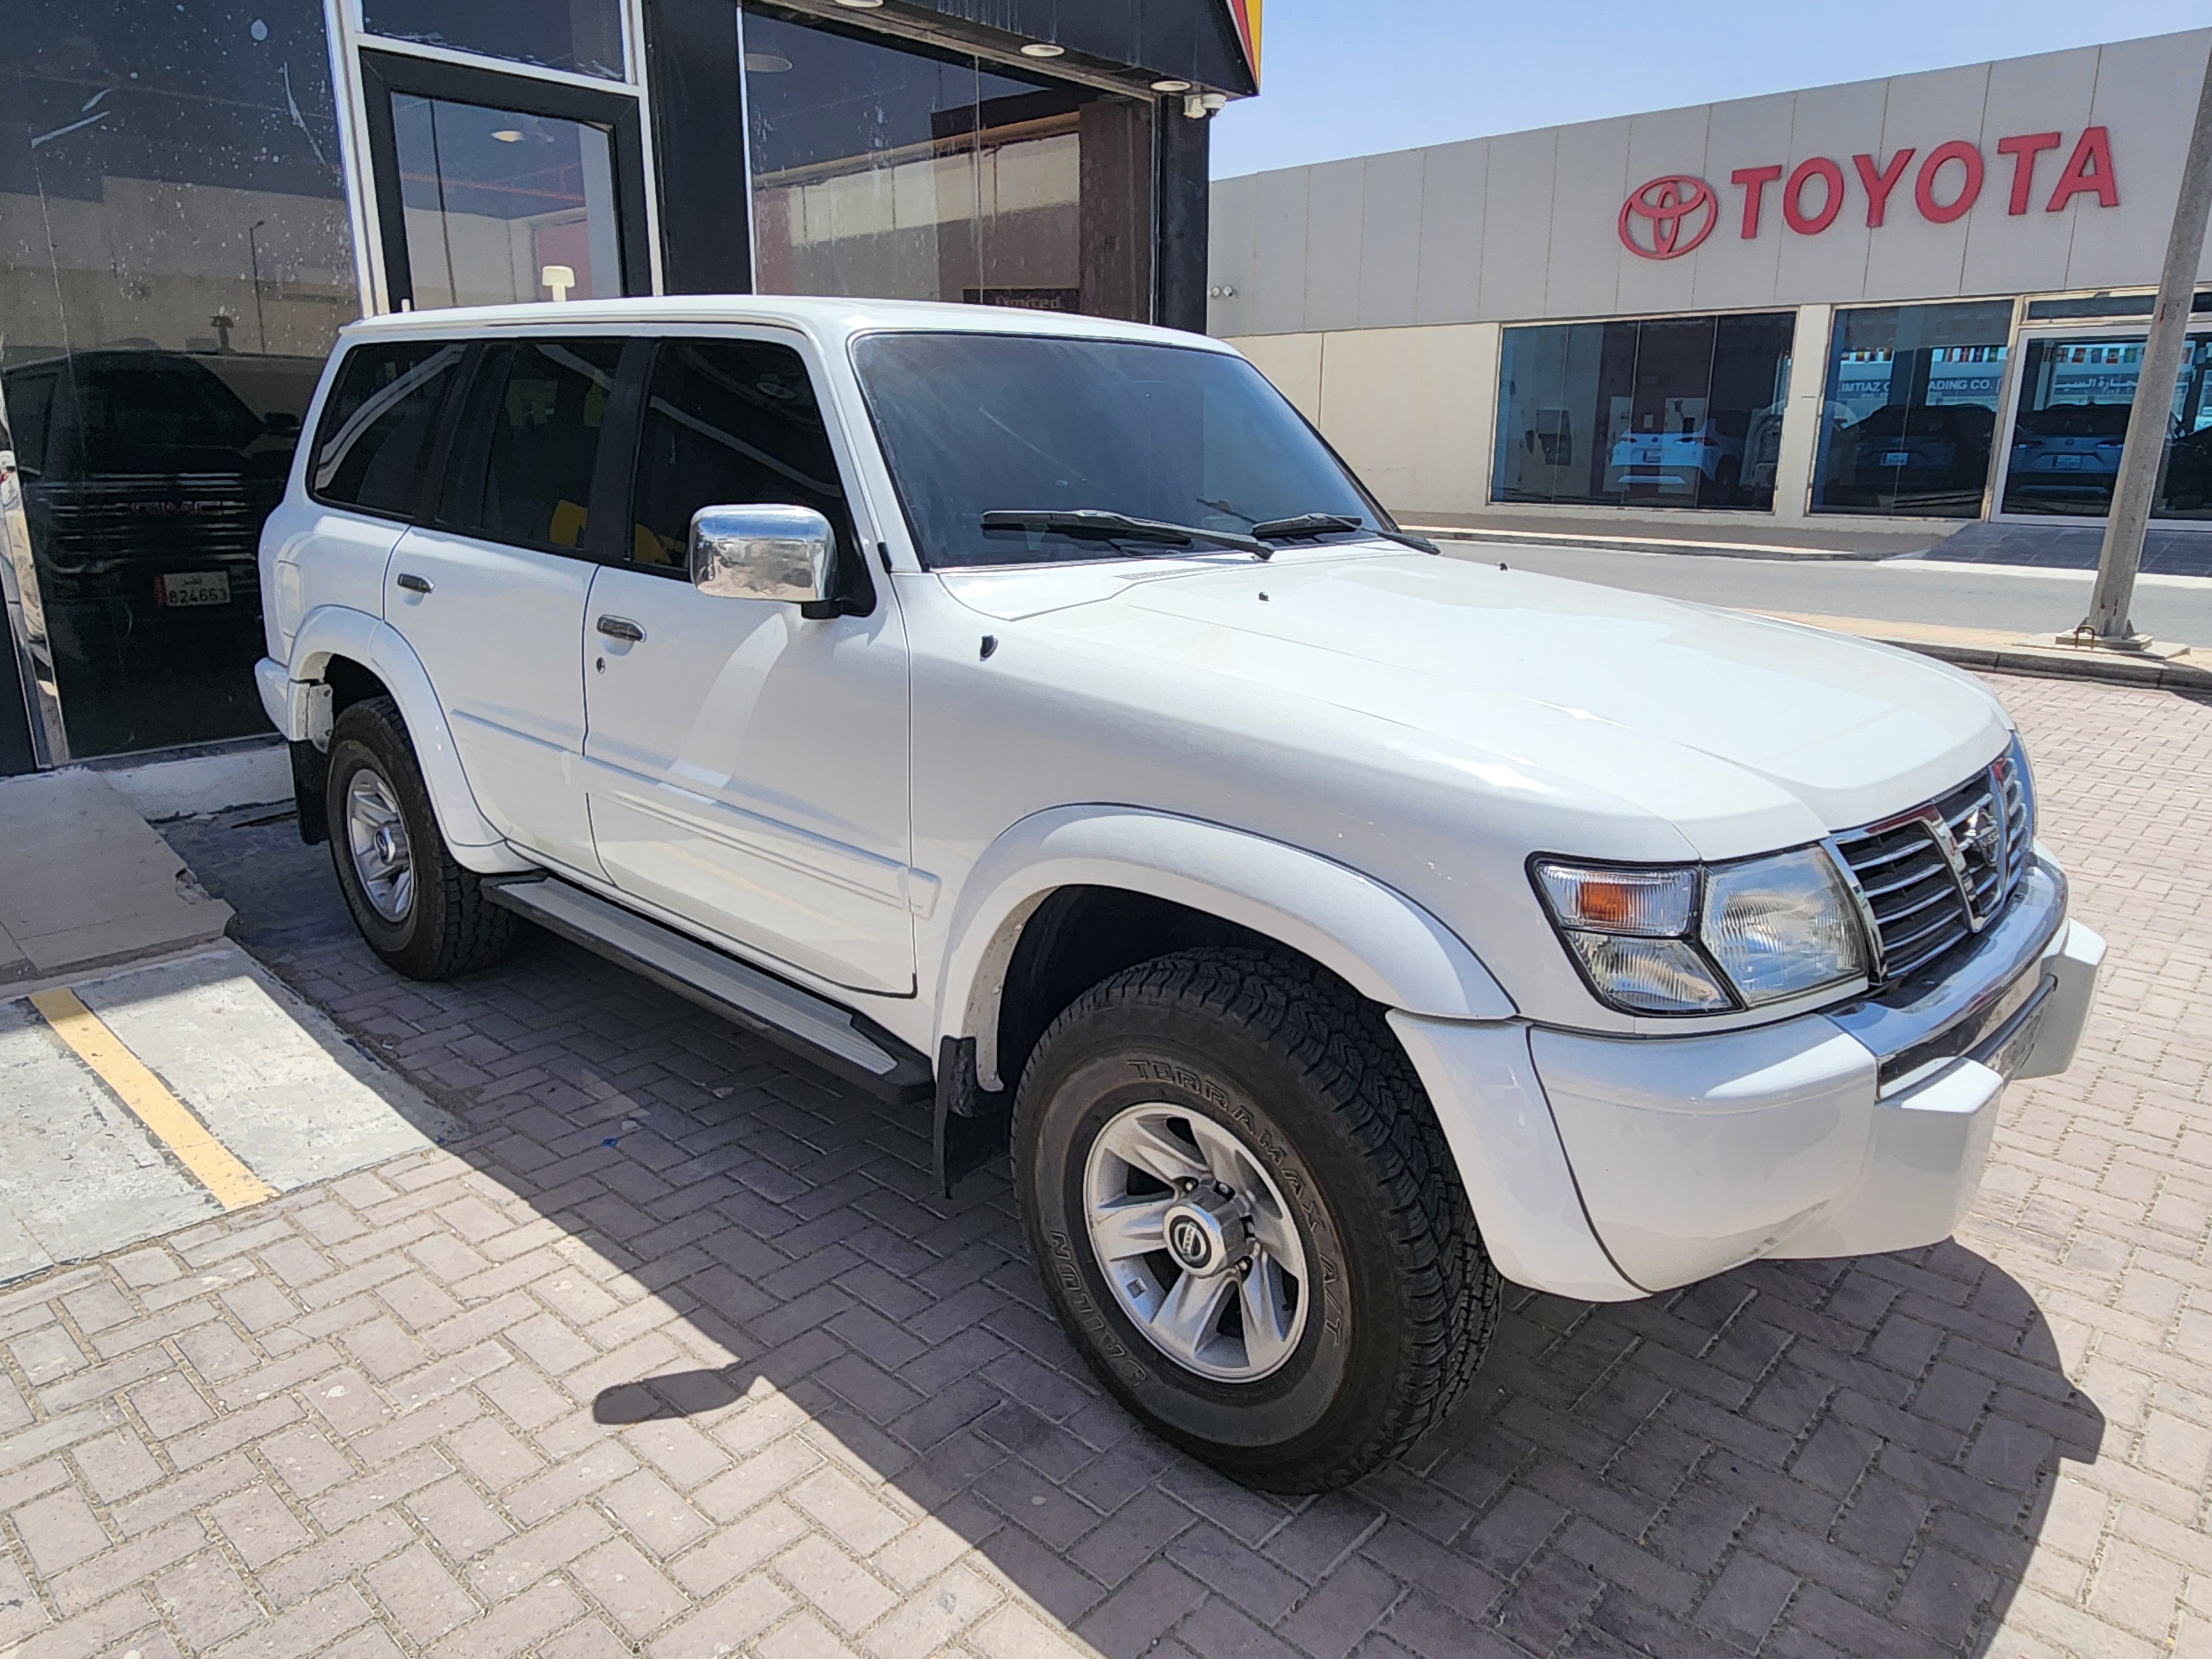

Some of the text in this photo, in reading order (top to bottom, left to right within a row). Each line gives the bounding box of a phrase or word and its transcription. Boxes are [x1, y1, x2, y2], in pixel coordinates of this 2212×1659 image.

[1731, 126, 2120, 239] TOYOTA
[1928, 379, 1993, 390] ADING CO.
[1126, 1059, 1343, 1347] TERRAMAX A/T
[1050, 1229, 1147, 1386] SAILUN
